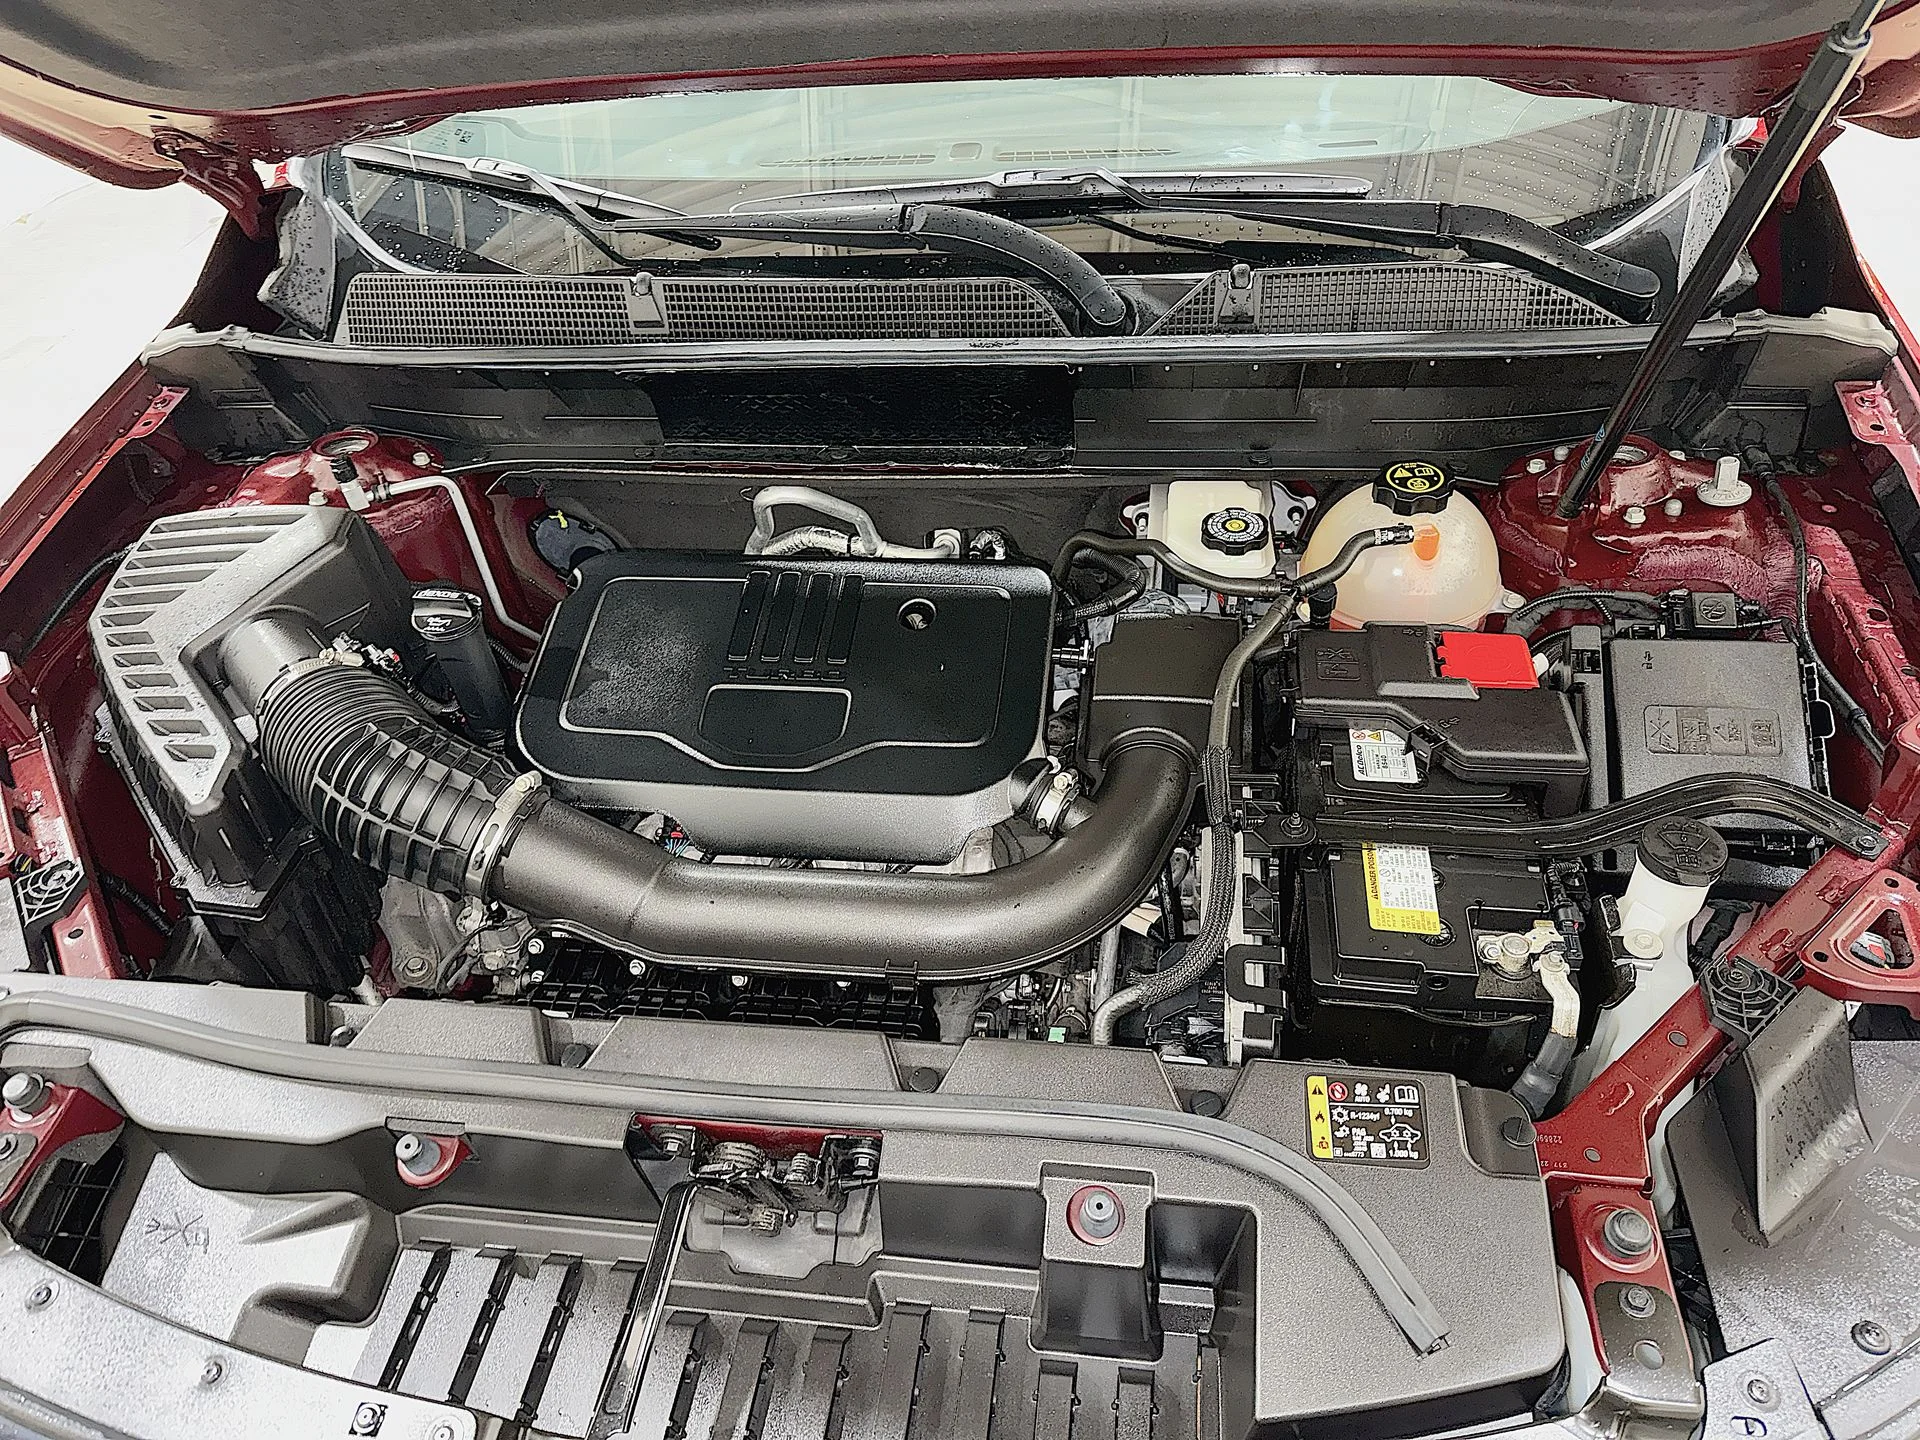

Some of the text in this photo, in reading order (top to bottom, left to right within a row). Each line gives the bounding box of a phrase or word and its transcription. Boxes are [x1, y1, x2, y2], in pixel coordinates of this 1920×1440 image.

[723, 667, 846, 682] TURBO
[1355, 744, 1365, 776] ACDelco
[1369, 870, 1378, 894] DANGER
[1354, 1095, 1371, 1103] AUTO
[1384, 1107, 1414, 1117] 0.700 kg
[1351, 1127, 1367, 1136] PAG
[1388, 1149, 1419, 1160] 1.000 kg
